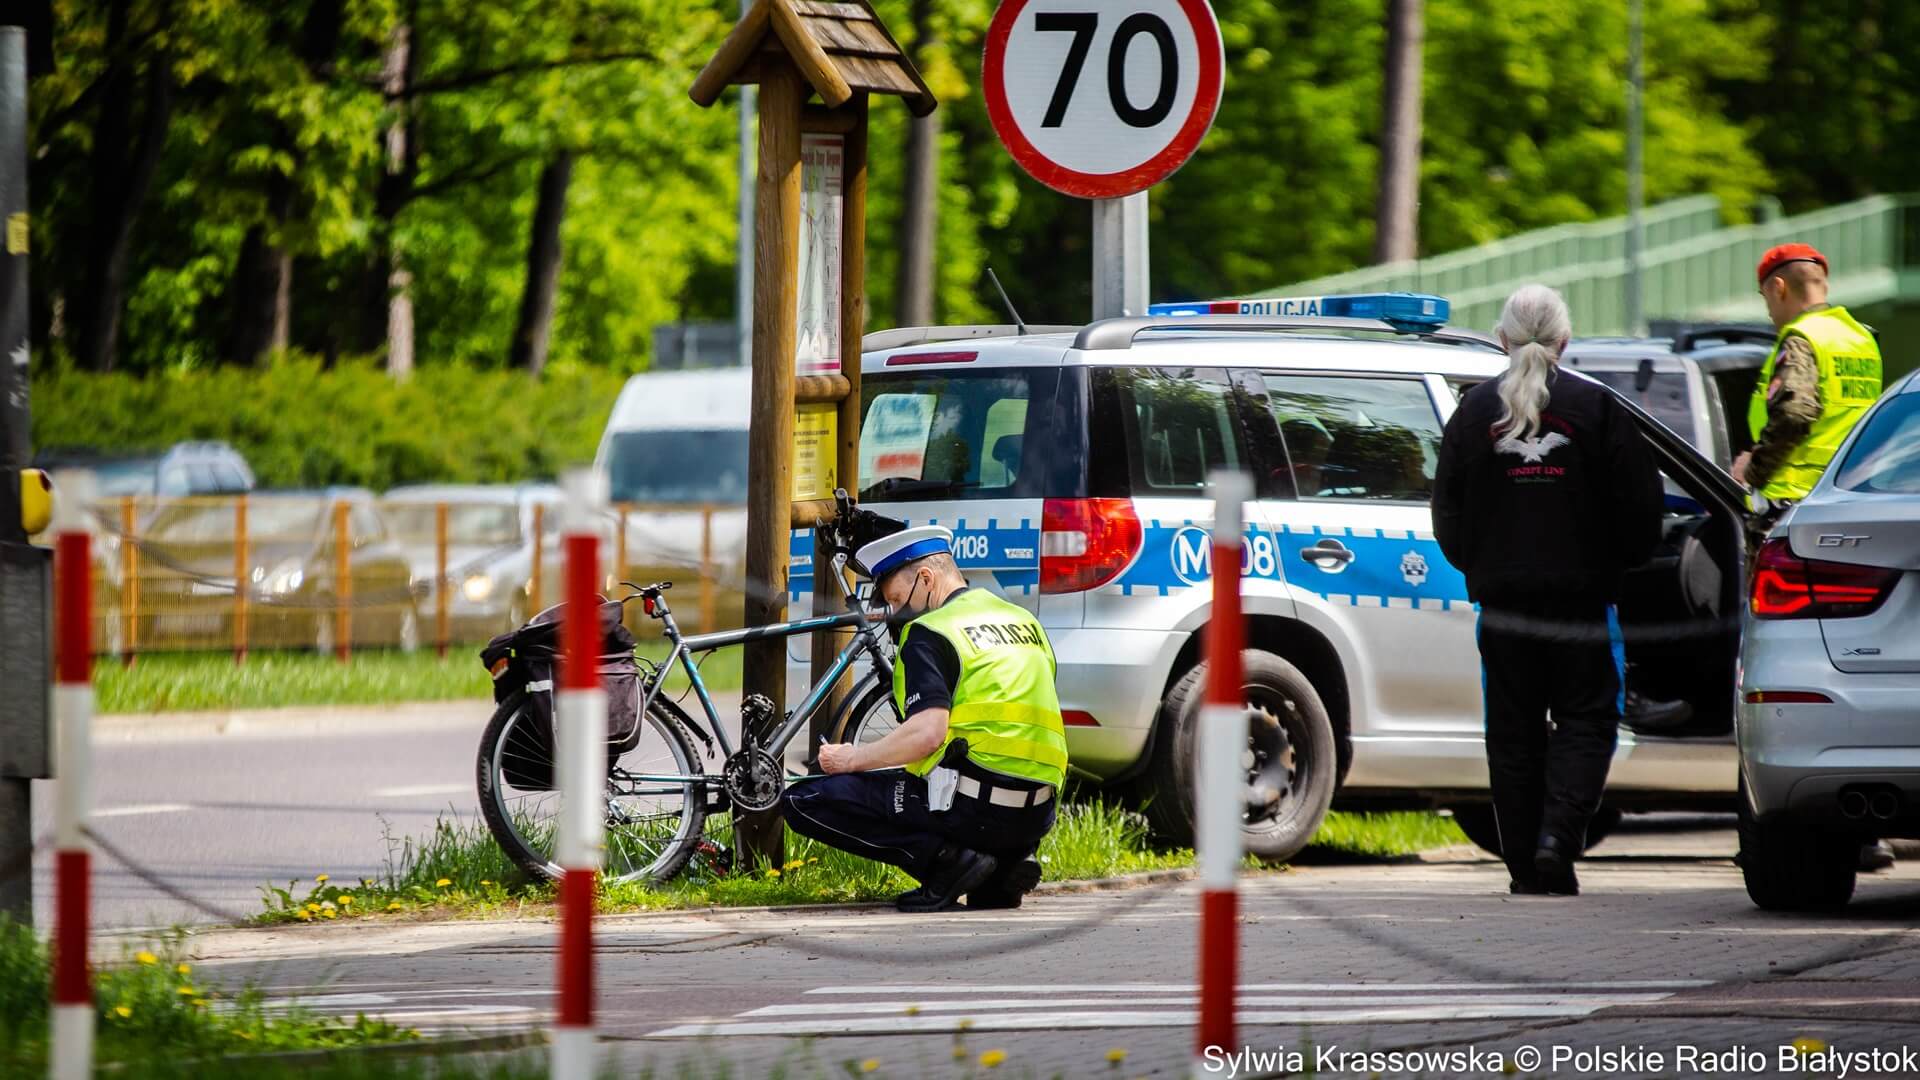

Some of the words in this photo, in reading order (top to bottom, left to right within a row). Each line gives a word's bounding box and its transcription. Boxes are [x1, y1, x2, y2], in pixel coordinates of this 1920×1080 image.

[1035, 12, 1179, 128] 70
[1240, 300, 1320, 316] POLICJA
[1544, 466, 1564, 475] LINE
[1178, 534, 1275, 577] M08
[1815, 533, 1873, 548] GT
[963, 623, 1046, 653] POLICJA
[894, 780, 906, 814] POLICJA
